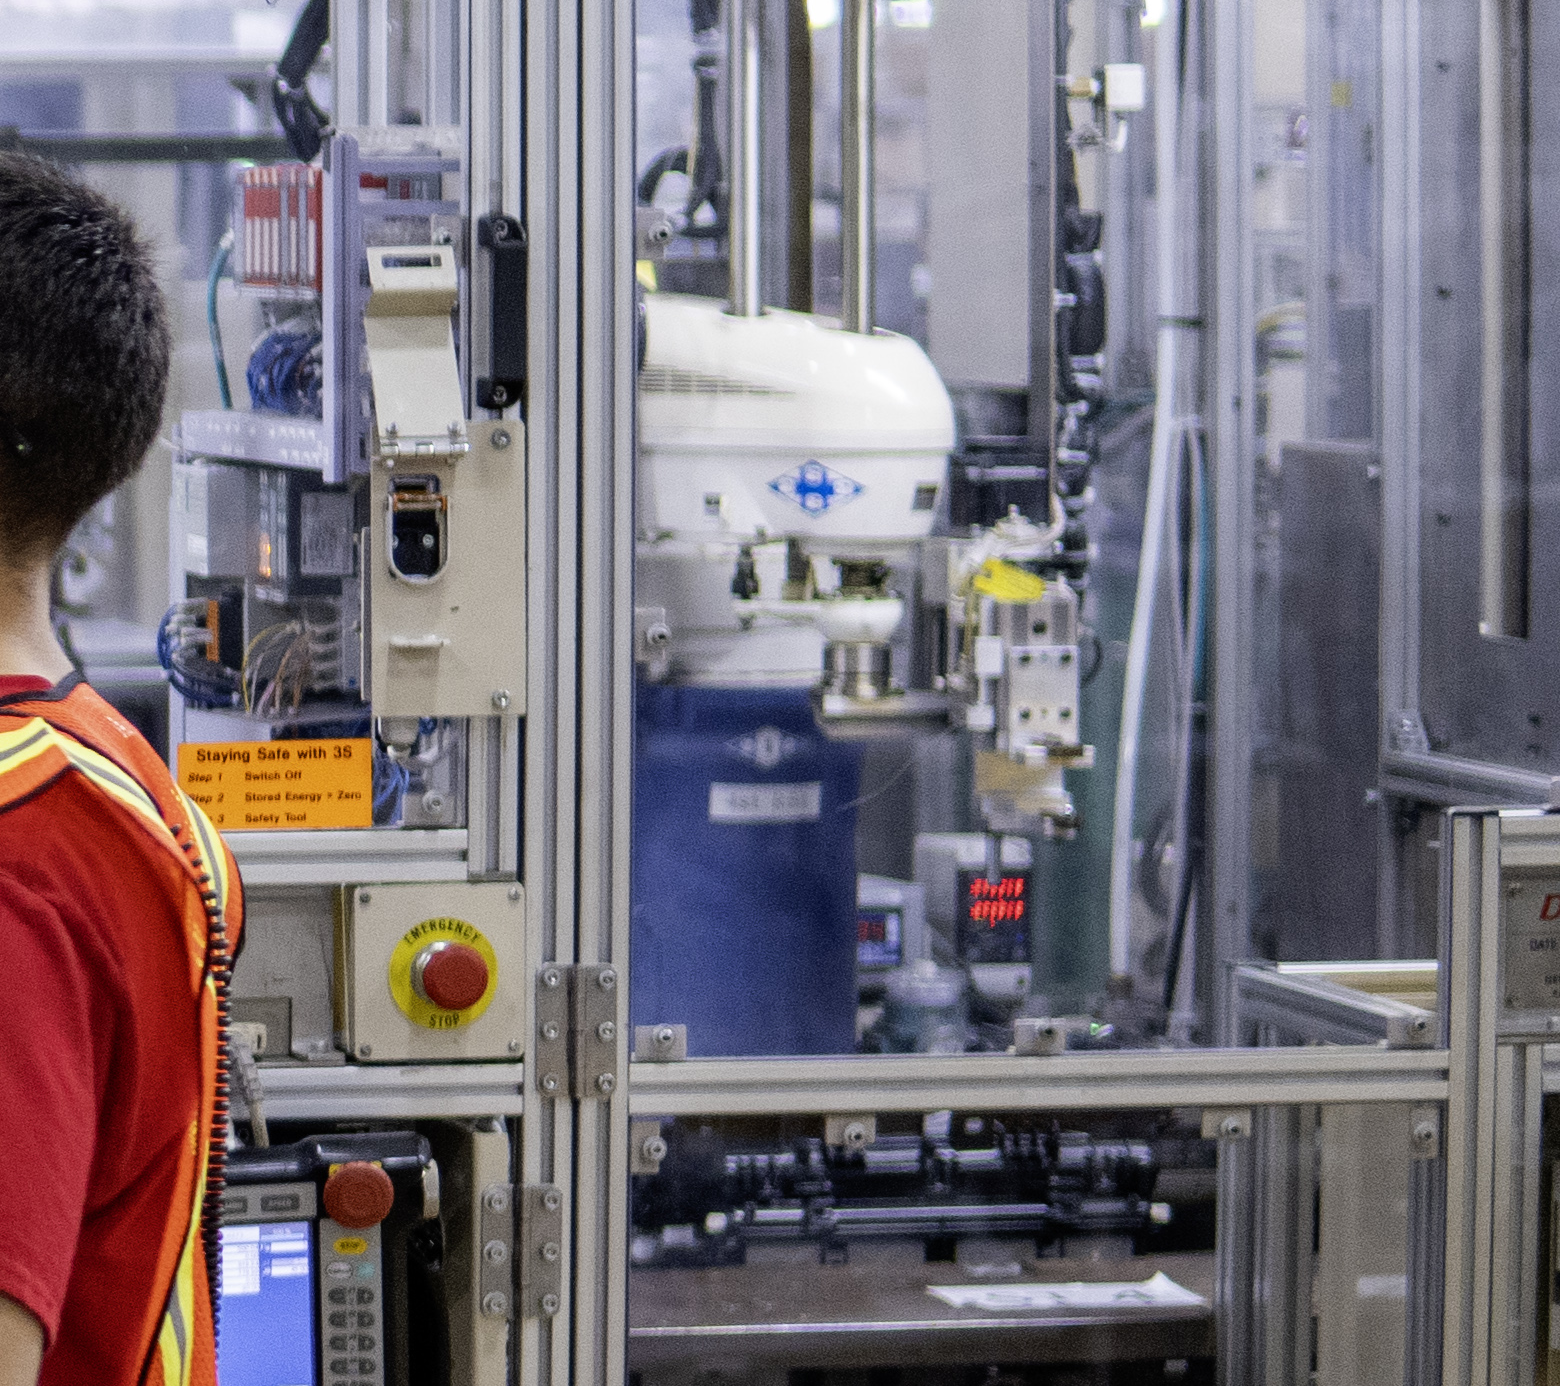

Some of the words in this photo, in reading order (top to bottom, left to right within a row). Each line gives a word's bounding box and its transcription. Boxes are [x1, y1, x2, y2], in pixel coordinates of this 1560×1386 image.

[196, 749, 250, 763] Staying
[257, 747, 290, 760] Safe
[297, 746, 326, 759] with
[333, 745, 352, 758] 3S
[188, 772, 212, 782] Step
[245, 771, 280, 781] Switch
[285, 770, 302, 779] Off
[218, 794, 224, 802] 2
[245, 792, 281, 801] Stored
[285, 792, 321, 802] Energy
[338, 790, 361, 800] Zero
[218, 814, 224, 823] 3
[245, 814, 279, 823] Safety
[286, 813, 306, 822] Tool
[404, 919, 481, 944] EMERGENCY
[429, 1013, 459, 1028] STOP
